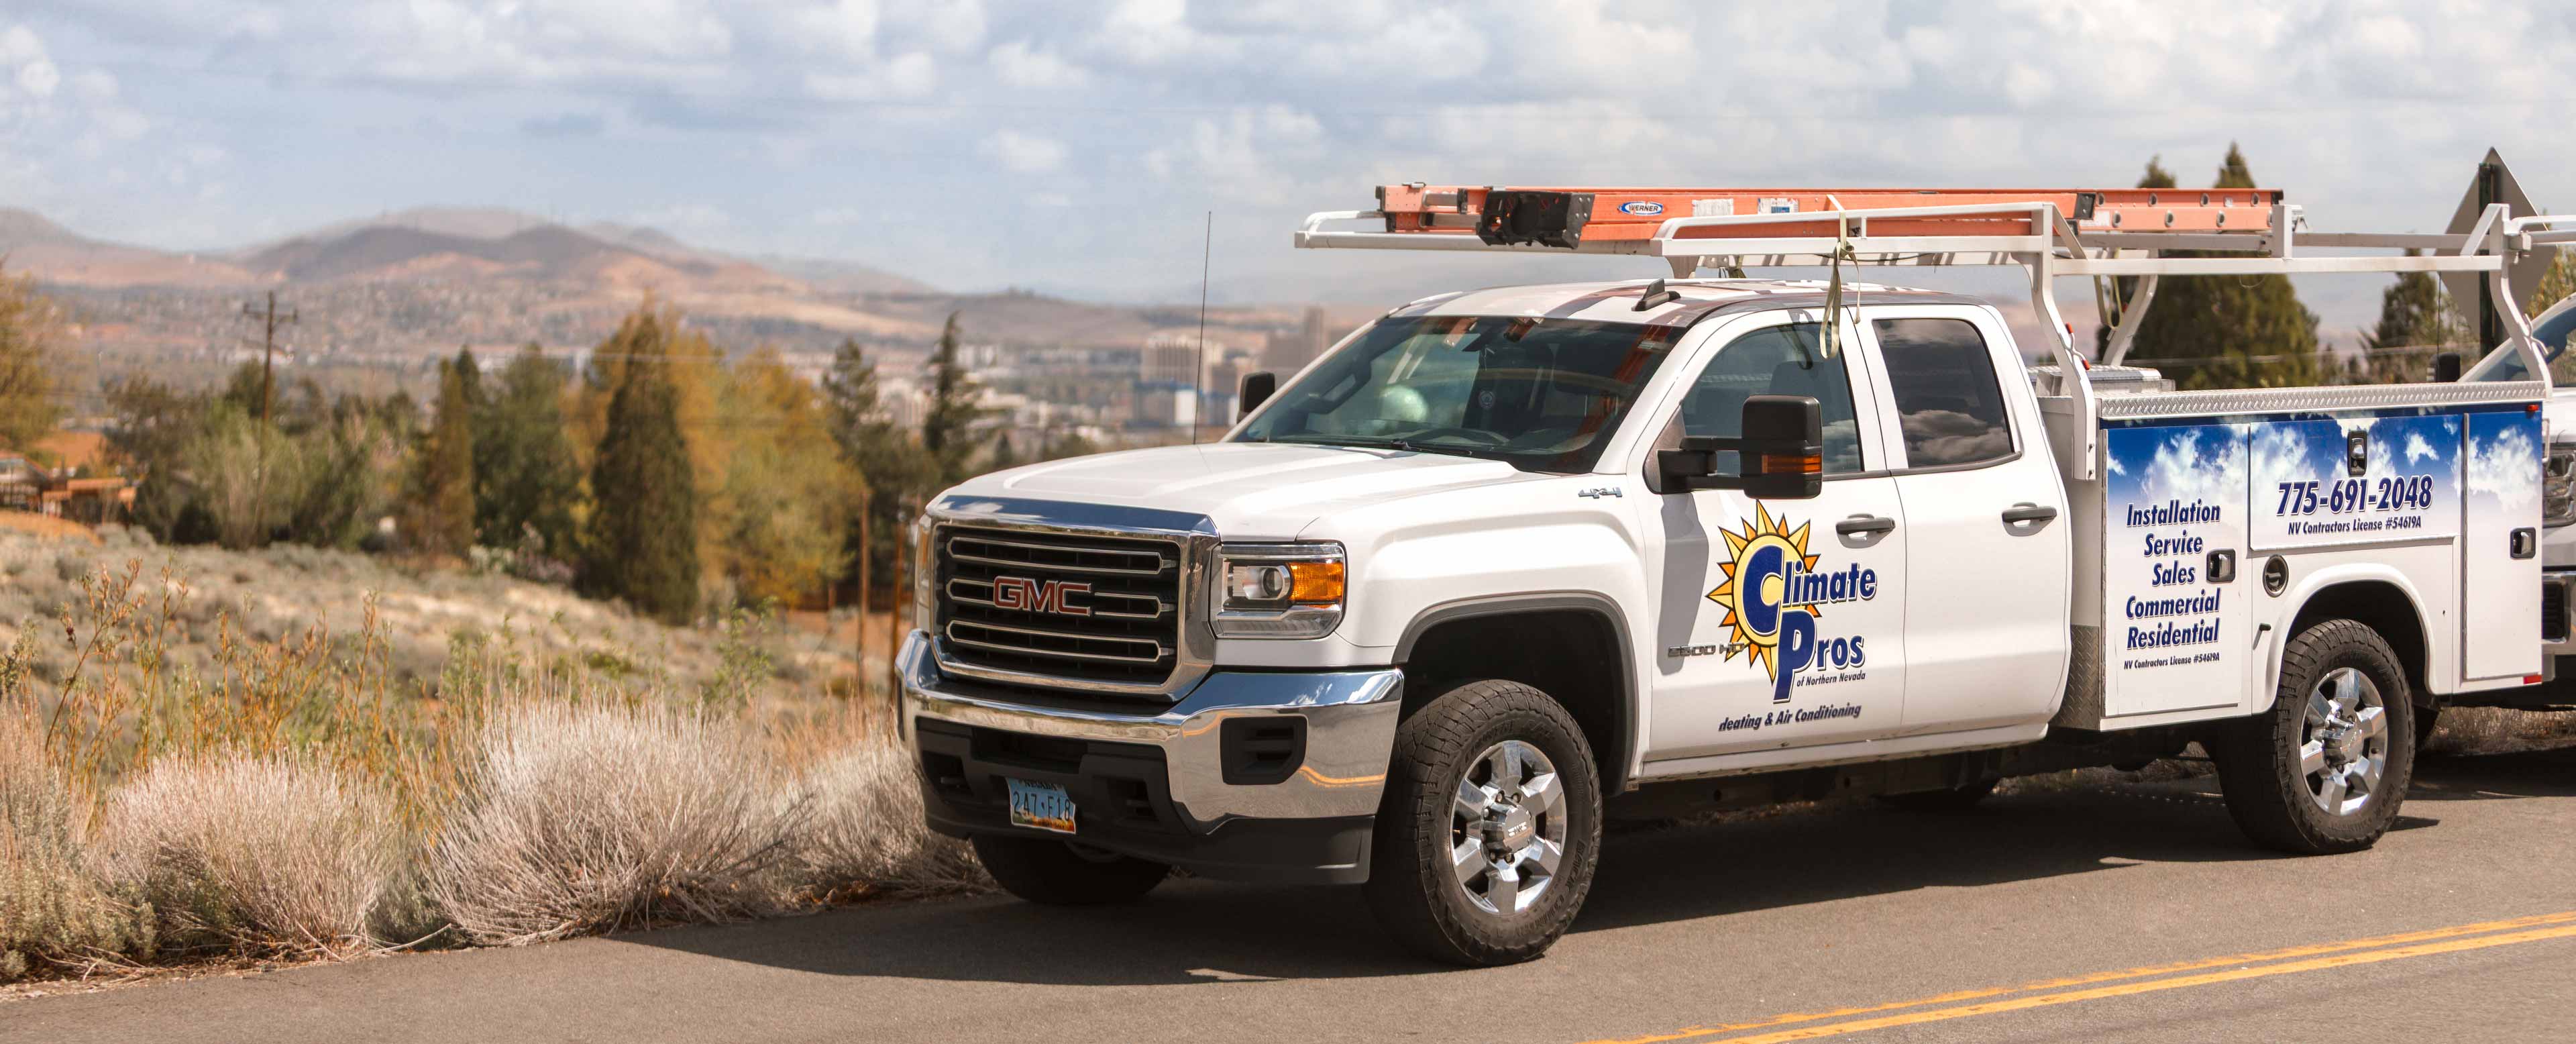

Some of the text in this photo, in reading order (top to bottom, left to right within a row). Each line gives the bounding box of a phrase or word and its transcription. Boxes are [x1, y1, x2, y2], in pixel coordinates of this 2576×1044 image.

[1629, 204, 1659, 212] WERNER
[2277, 474, 2434, 516] 775-691-2048
[2127, 498, 2221, 527] Installation
[2288, 515, 2422, 535] NV Contractors License #54619A
[2144, 529, 2203, 557] Service
[2152, 560, 2196, 587] Sales
[994, 576, 1091, 617] GMC
[1741, 544, 1877, 636] Climate
[2126, 587, 2221, 619] Commercial
[2127, 617, 2220, 650] Residential
[1773, 610, 1865, 704] Pros
[2124, 651, 2220, 670] NV Contractors License #54619A
[1796, 670, 1866, 687] of Northern Nevada
[1764, 712, 1774, 726] &
[1775, 709, 1793, 725] Air
[1795, 702, 1862, 722] Conditioning
